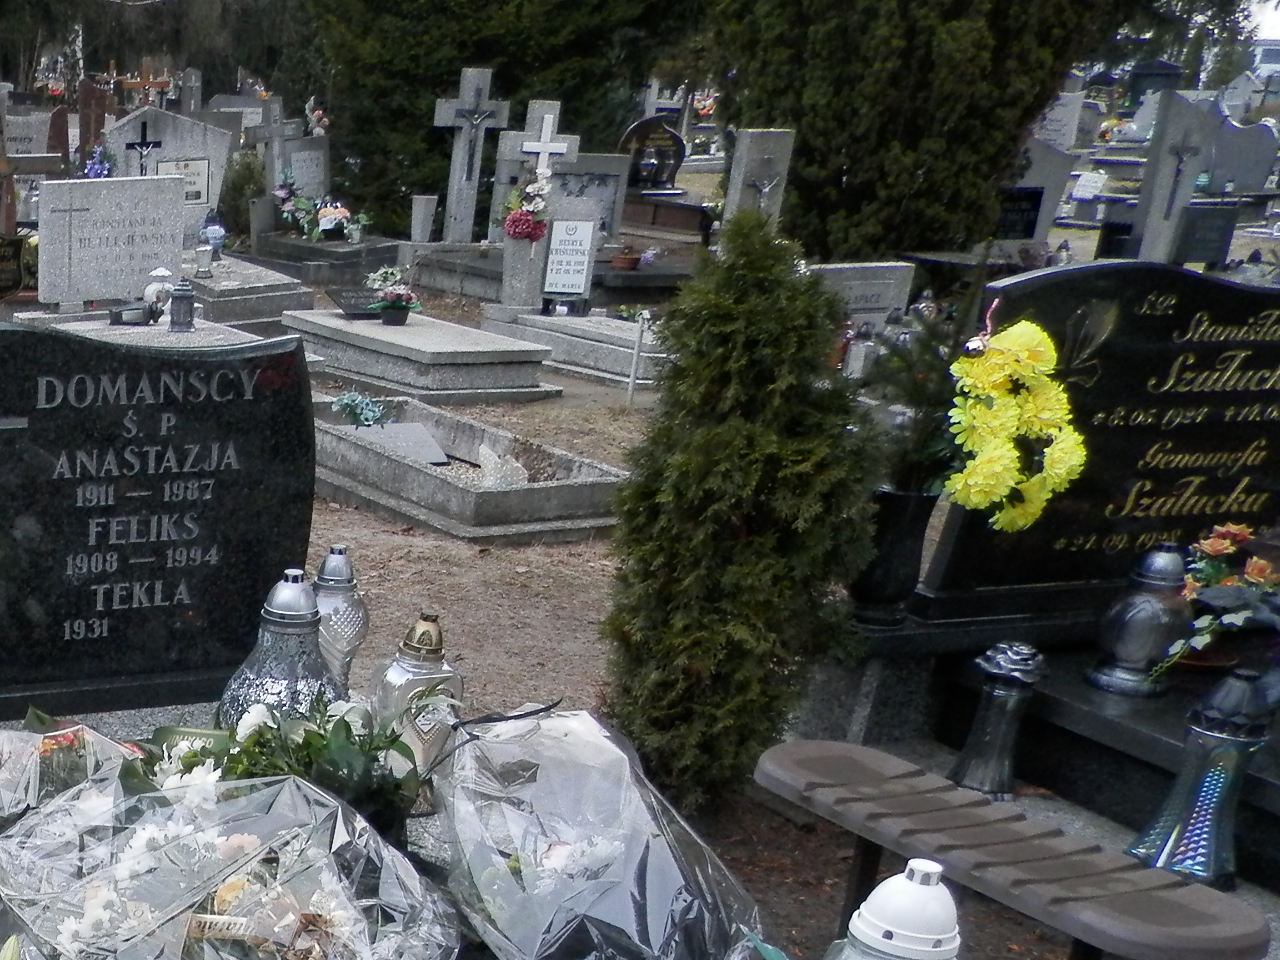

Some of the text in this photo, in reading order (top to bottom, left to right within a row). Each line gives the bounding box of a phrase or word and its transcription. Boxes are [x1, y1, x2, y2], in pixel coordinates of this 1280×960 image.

[52, 442, 240, 479] ANASTAZJA
[75, 484, 115, 507] 1911
[162, 479, 216, 502] 1987
[87, 511, 200, 546] FELIKS
[65, 551, 119, 576] 1908
[165, 544, 220, 568] 1994
[89, 578, 193, 611] TEKLA
[62, 616, 111, 641] 1931
